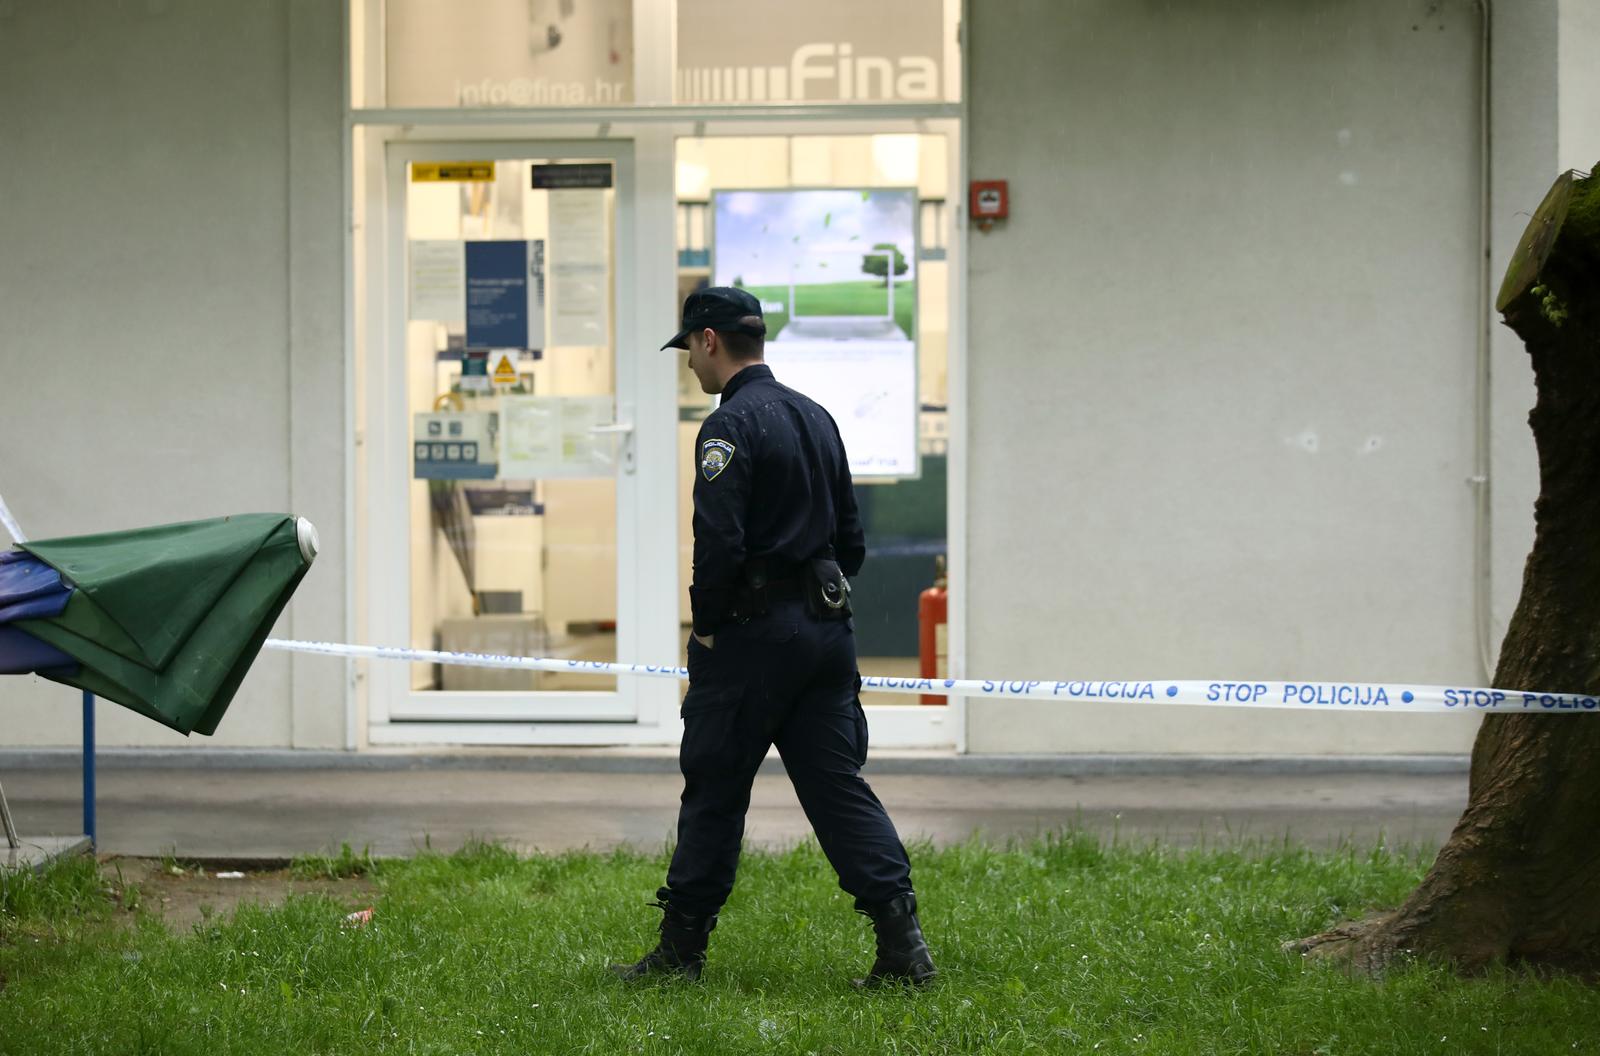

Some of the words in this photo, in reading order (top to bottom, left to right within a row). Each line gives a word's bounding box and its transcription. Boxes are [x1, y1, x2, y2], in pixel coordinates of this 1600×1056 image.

[455, 78, 624, 105] info@fina.hr
[704, 441, 732, 452] POLICIJA
[861, 677, 932, 690] LICIJA
[982, 680, 1040, 694] STOP
[1054, 681, 1154, 699] POLICIJA
[1207, 683, 1267, 702] STOP
[1283, 684, 1389, 706] POLICIJA
[1444, 689, 1506, 707] STOP
[1522, 693, 1600, 709] POLIC
